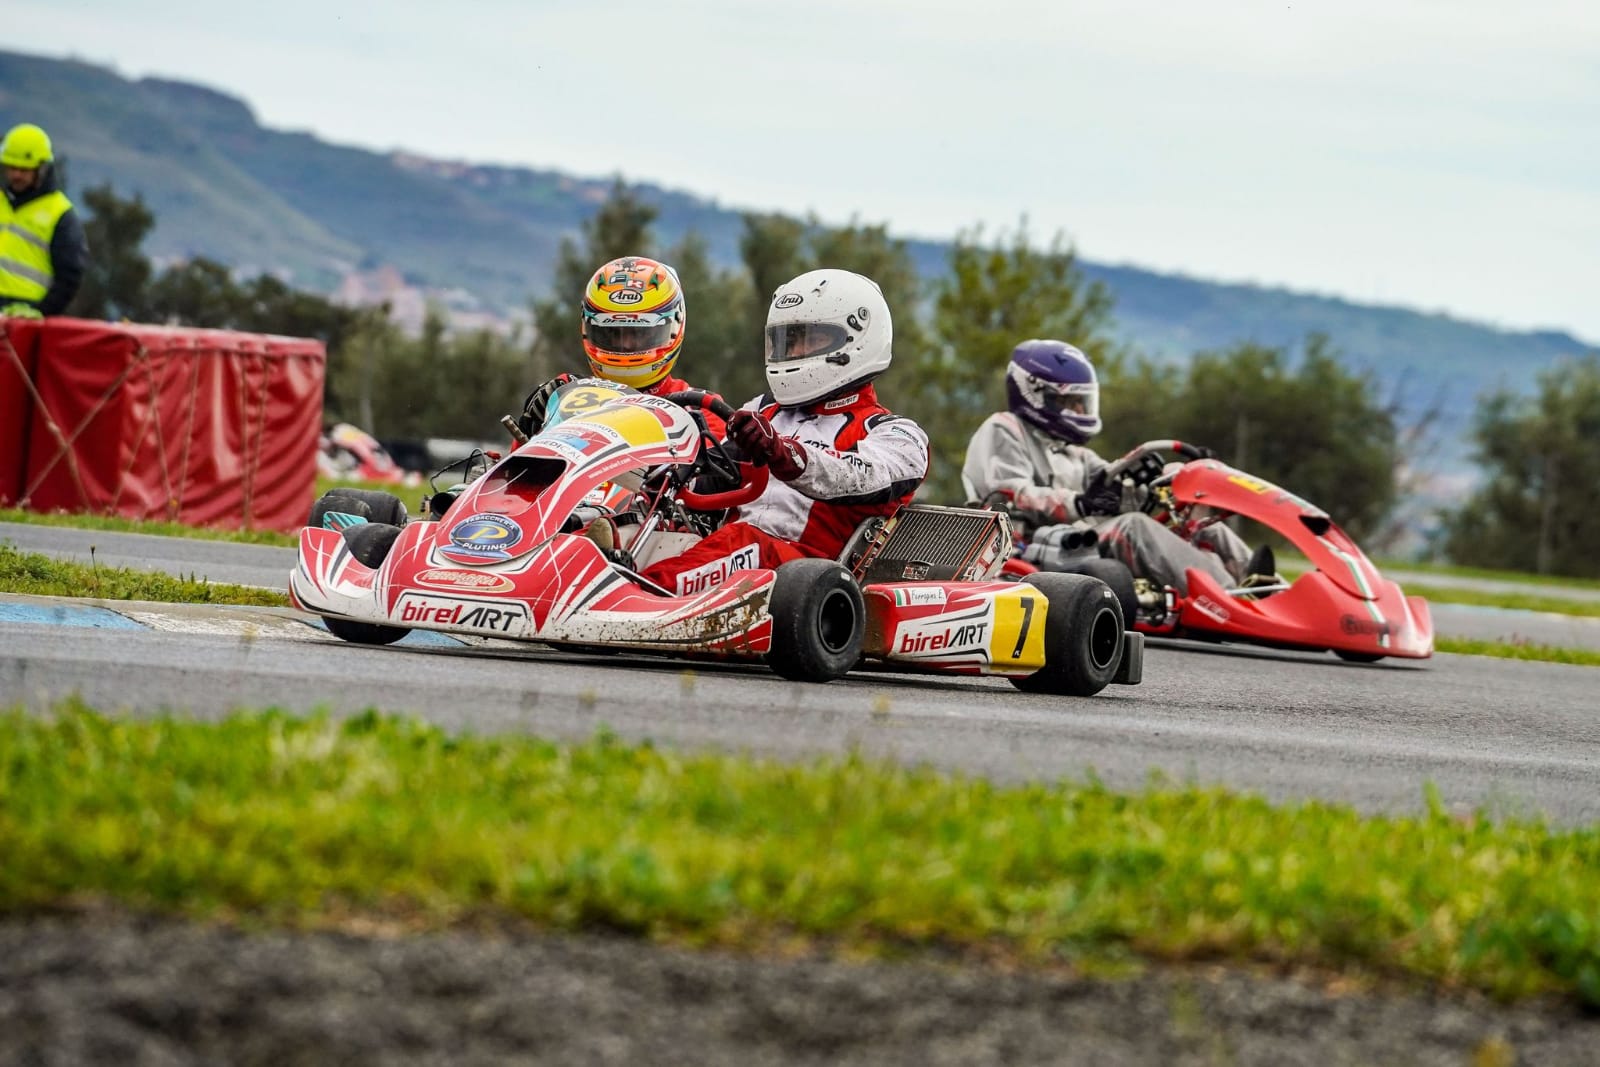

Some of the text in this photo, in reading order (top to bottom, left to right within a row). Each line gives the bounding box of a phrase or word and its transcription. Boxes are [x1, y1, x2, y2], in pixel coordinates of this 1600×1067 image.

[611, 290, 639, 301] Arai
[776, 295, 800, 305] Arai
[465, 515, 516, 530] TABACCHERIA
[462, 542, 508, 551] PLUTINO
[682, 548, 754, 597] birelART
[401, 600, 523, 632] birelART
[1012, 596, 1035, 658] 7
[900, 622, 988, 654] birelART
